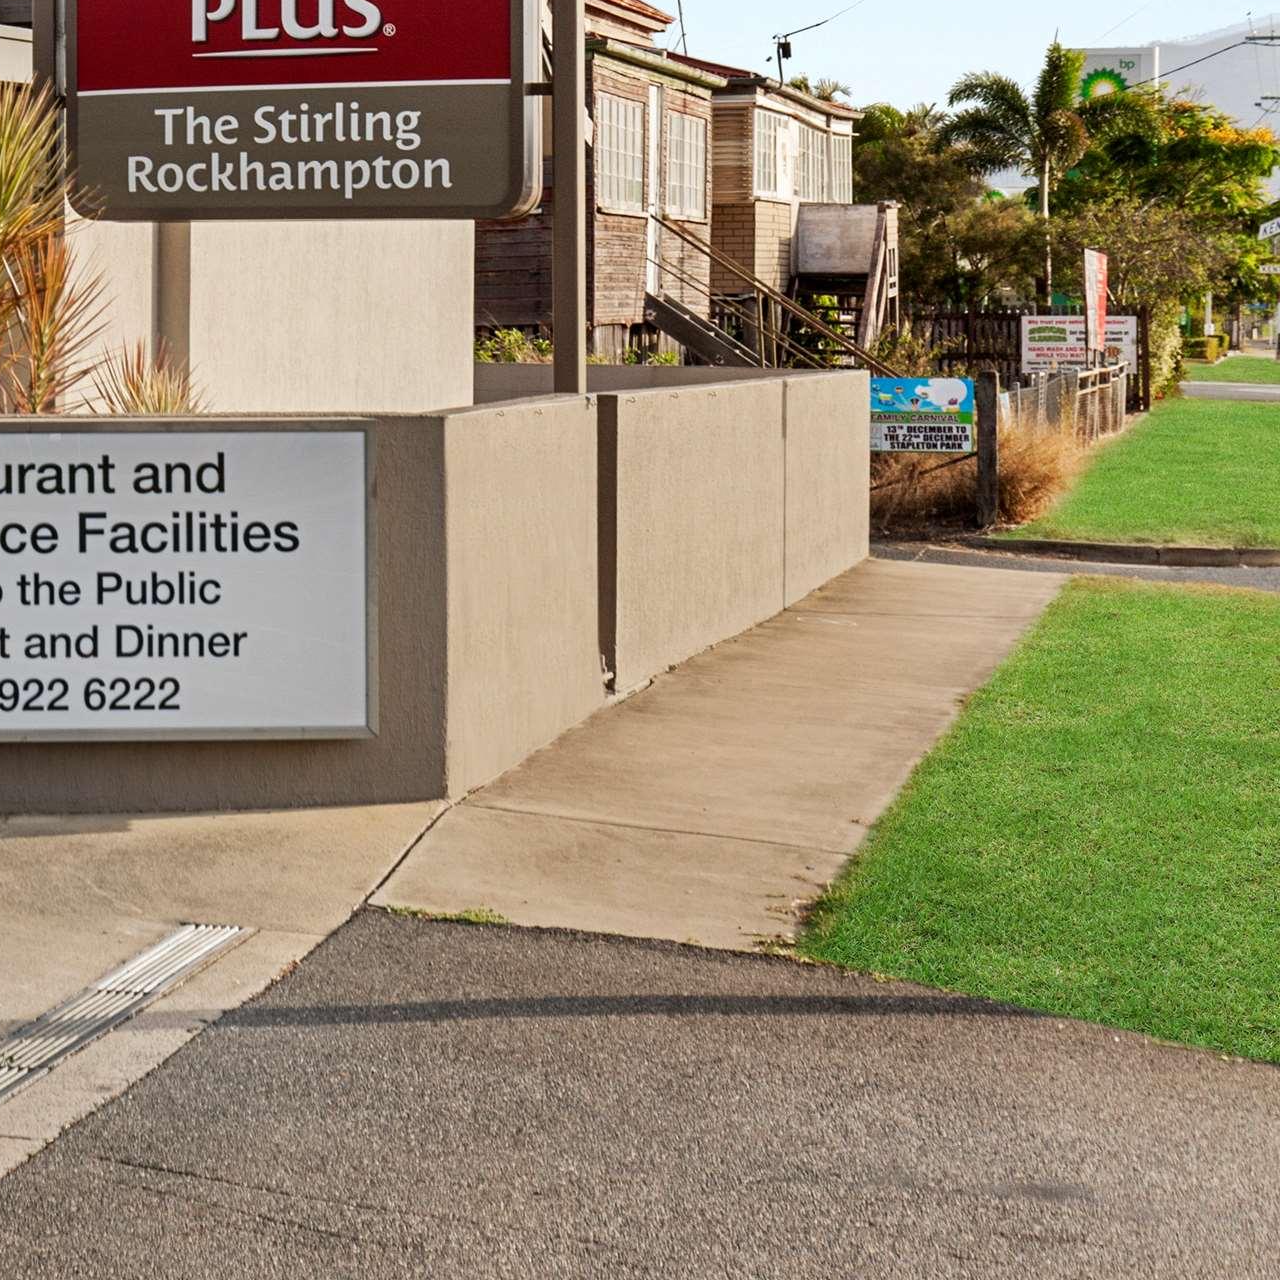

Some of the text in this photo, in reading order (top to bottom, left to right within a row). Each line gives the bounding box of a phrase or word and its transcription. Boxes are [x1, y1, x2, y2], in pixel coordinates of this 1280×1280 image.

[1119, 58, 1135, 71] bp
[153, 101, 422, 151] The Stirling
[127, 151, 453, 199] Rockhampton
[910, 413, 960, 423] CARNIVAL
[923, 433, 970, 442] DECEMBER
[132, 451, 226, 495] and
[78, 510, 300, 554] Facilities
[16, 572, 81, 606] the
[96, 571, 221, 606] Public
[24, 624, 99, 659] and
[115, 624, 248, 658] Dinner
[83, 677, 181, 712] 6222
